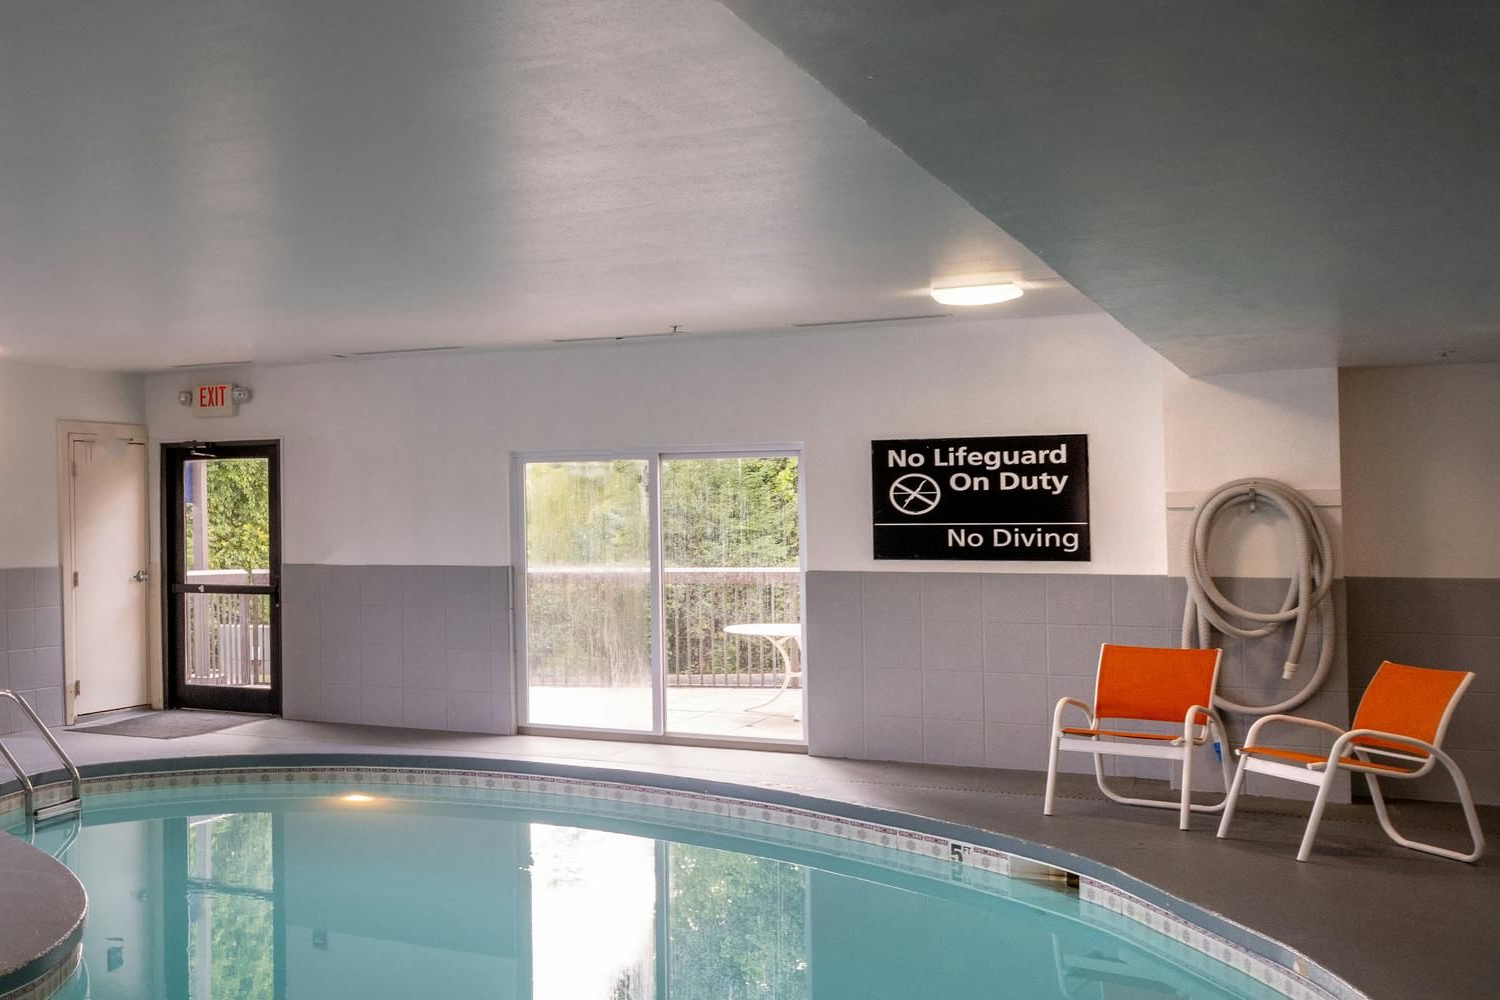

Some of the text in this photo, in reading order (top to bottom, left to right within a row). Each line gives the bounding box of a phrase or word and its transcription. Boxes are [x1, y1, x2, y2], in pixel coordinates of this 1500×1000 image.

[200, 386, 226, 407] EXIT
[888, 444, 1067, 470] No Lifeguard
[950, 472, 1068, 495] On Duty
[948, 528, 1079, 552] No Diving
[951, 843, 963, 862] 5
